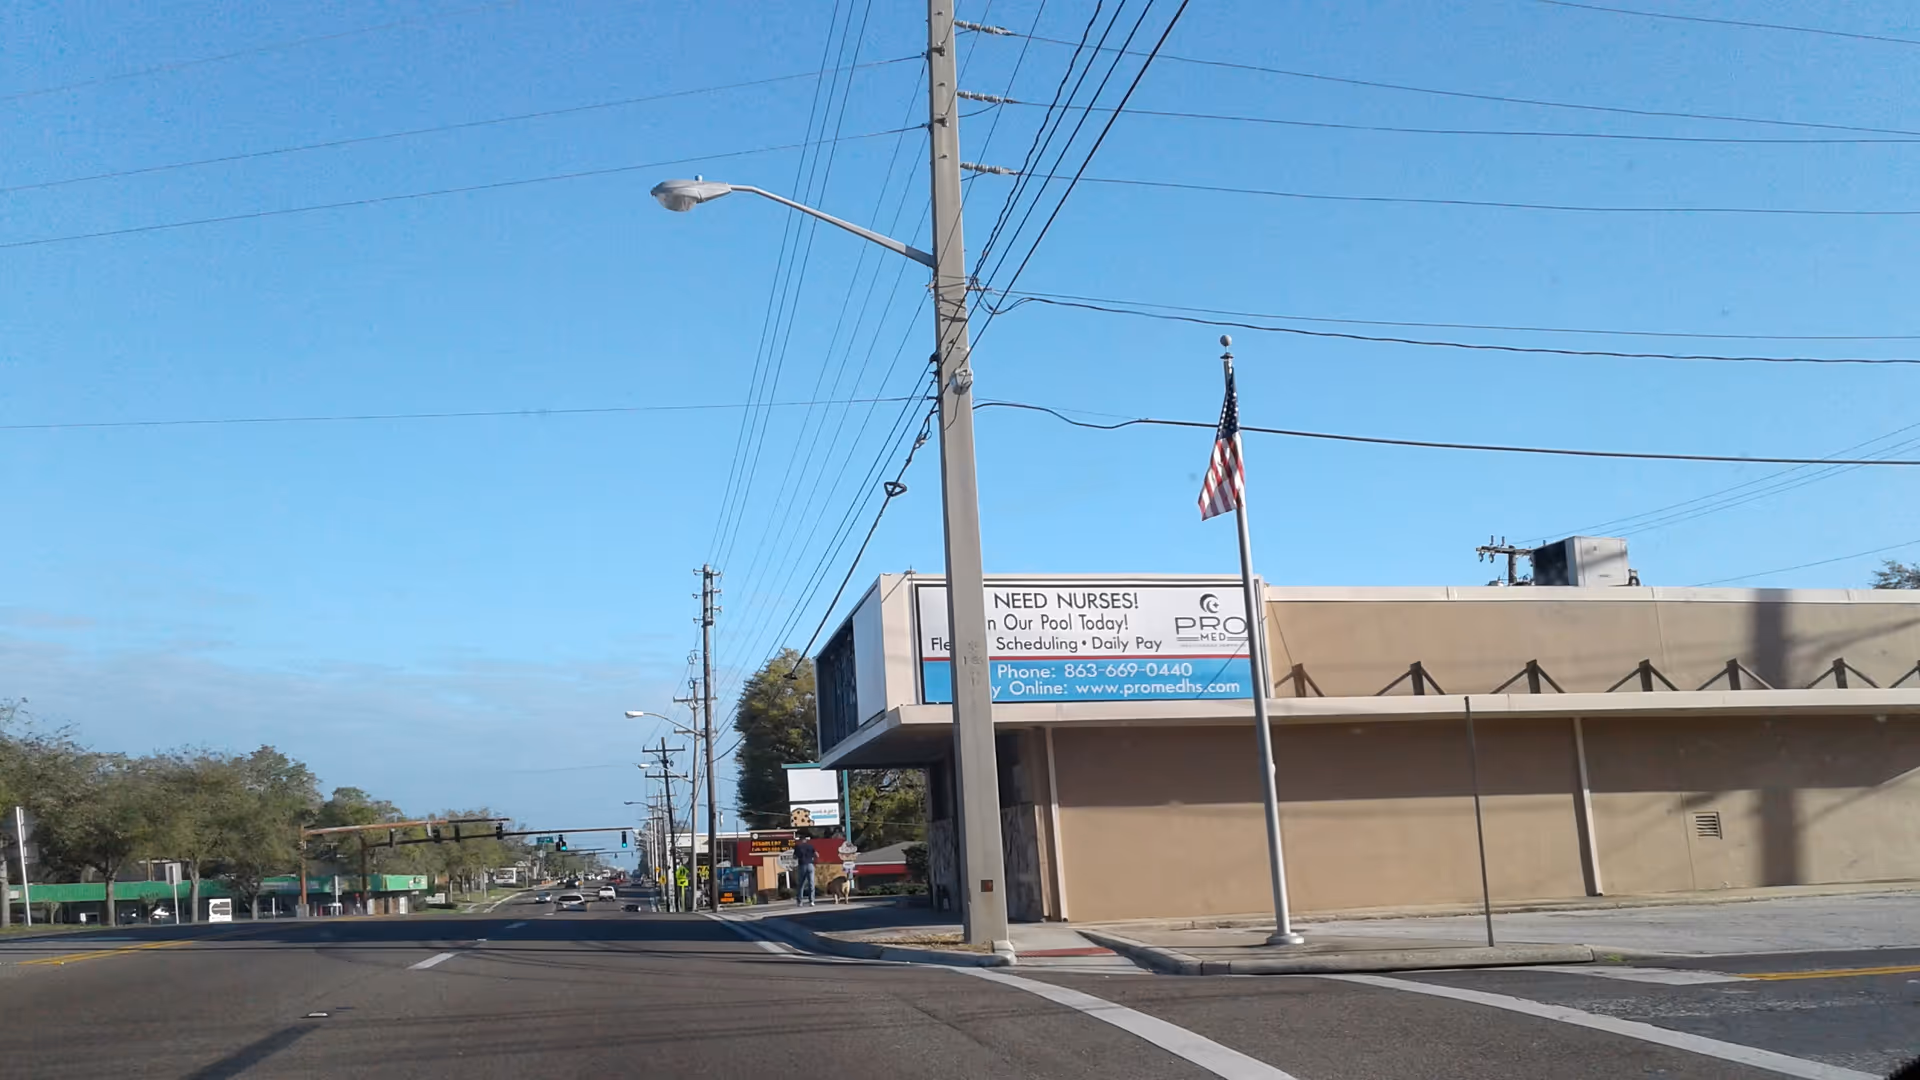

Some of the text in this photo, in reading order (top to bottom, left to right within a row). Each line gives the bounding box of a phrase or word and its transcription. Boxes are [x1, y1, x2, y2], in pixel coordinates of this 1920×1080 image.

[995, 592, 1139, 609] NEED NURSES!
[1003, 614, 1034, 631] Our
[1041, 614, 1073, 631] Pool
[1078, 613, 1129, 634] Today!
[1175, 616, 1248, 634] PRO
[996, 636, 1162, 652] Scheduling Daily Pay
[1200, 632, 1226, 641] MED
[997, 662, 1193, 679] Phone: 863-669-0440
[1009, 681, 1068, 695] Online:
[1076, 681, 1240, 696] www.promedhs.com
